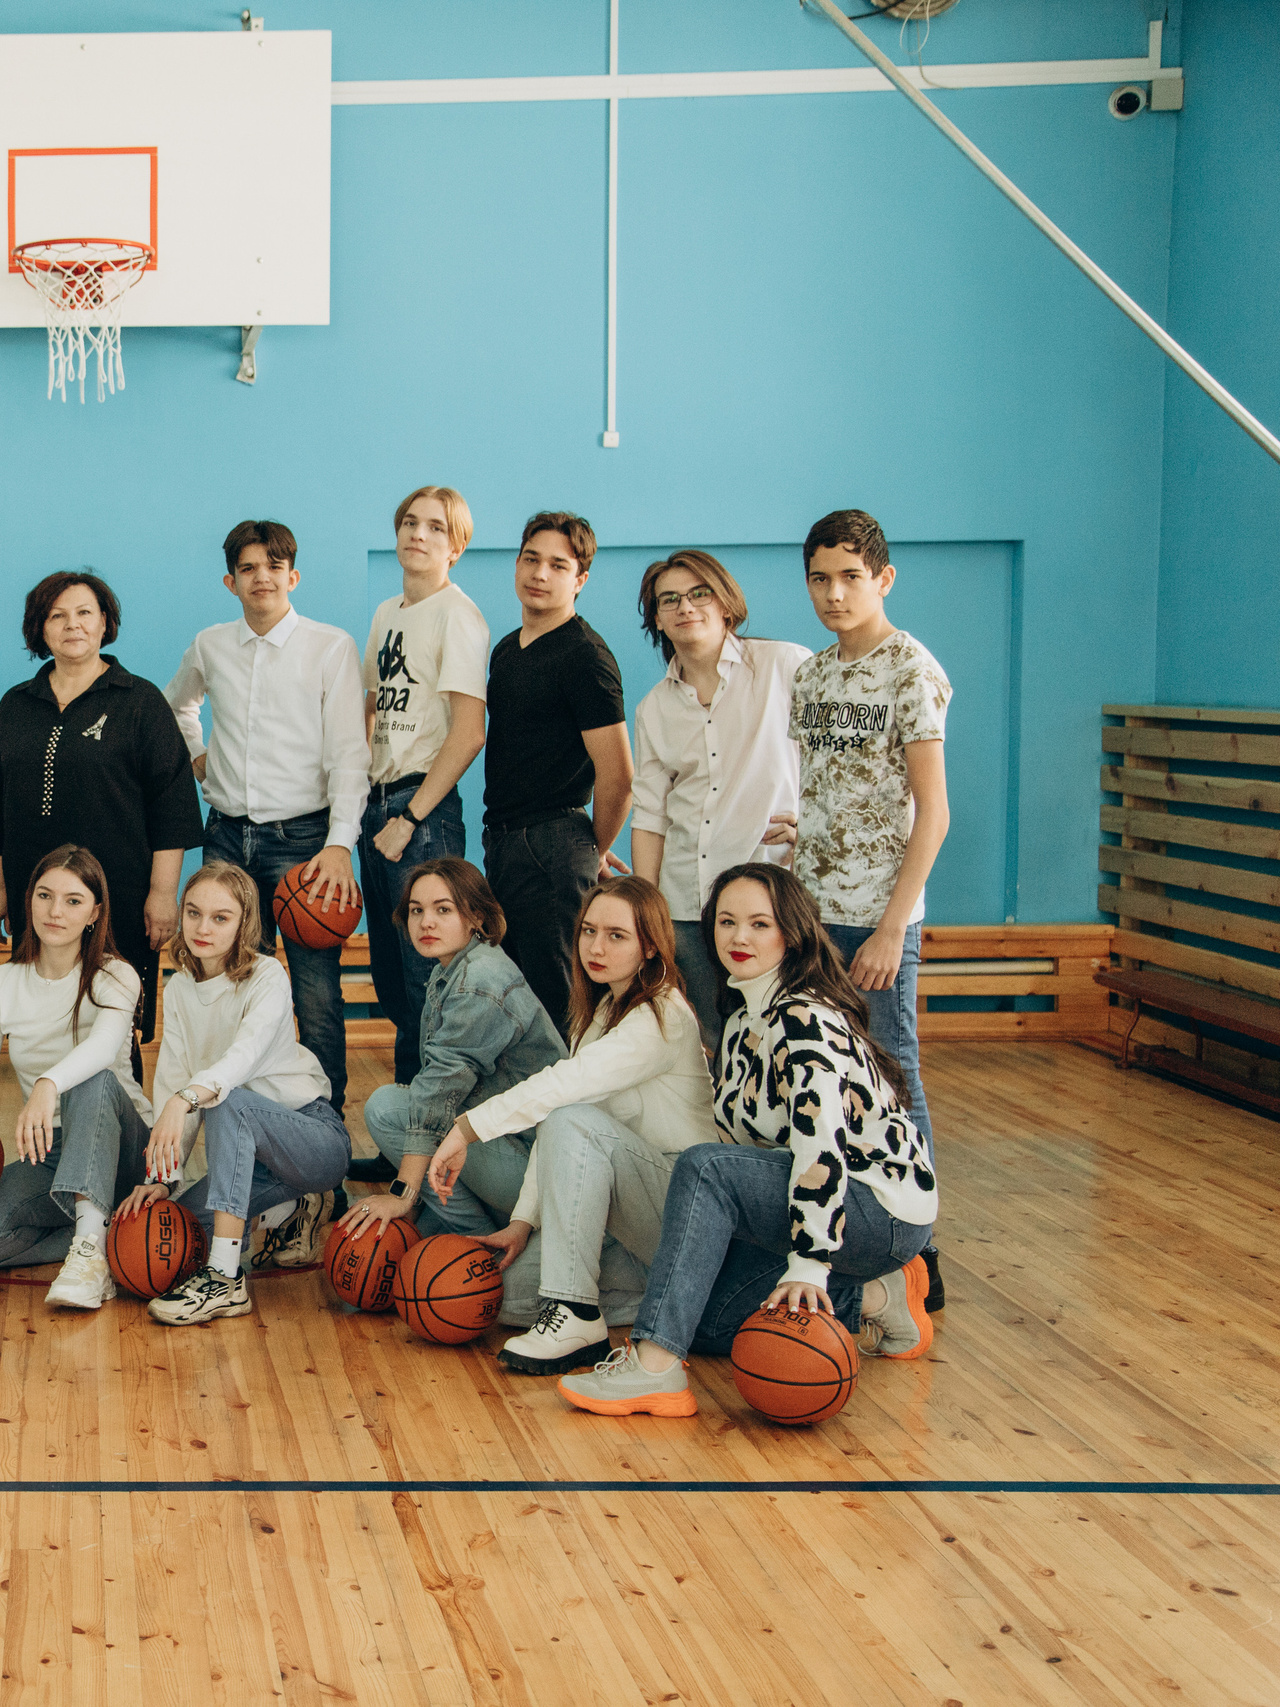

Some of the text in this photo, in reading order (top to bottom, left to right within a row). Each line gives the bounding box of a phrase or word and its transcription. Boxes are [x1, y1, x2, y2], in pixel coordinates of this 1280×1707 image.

[391, 721, 416, 732] Brand
[802, 702, 889, 731] UNICORN
[155, 1206, 173, 1270] JÖGEL
[462, 1257, 499, 1284] JÖGE
